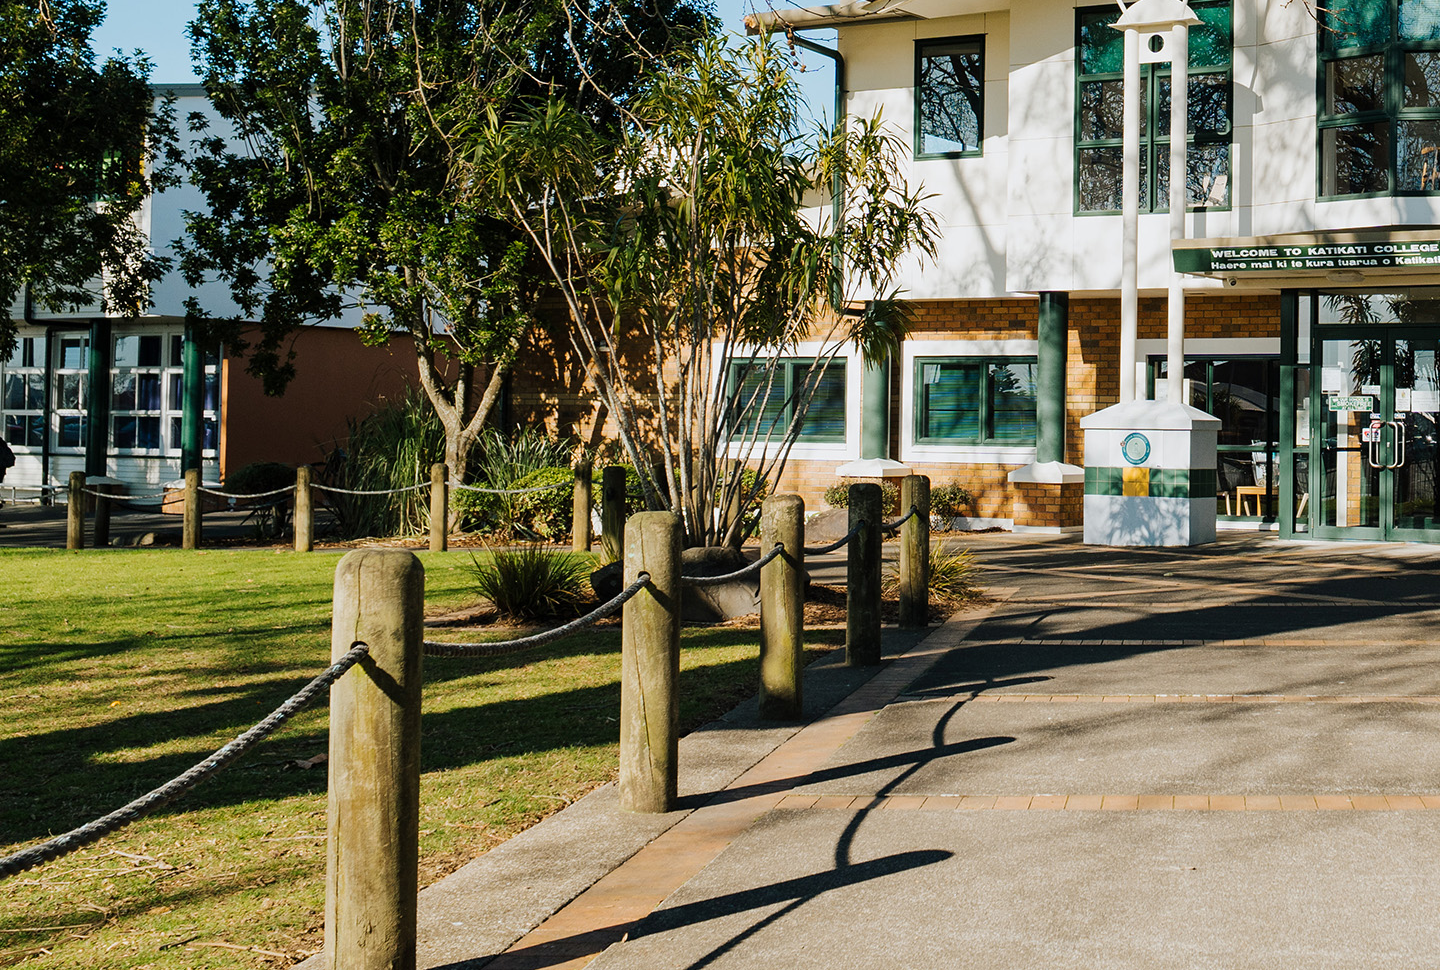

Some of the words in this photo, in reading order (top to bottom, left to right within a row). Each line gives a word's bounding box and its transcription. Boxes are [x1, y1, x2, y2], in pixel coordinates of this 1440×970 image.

[1211, 249, 1278, 258] WELCOME
[1284, 248, 1302, 256] TO
[1307, 246, 1367, 256] KATIKATI
[1373, 243, 1440, 253] COLLEGE
[1251, 260, 1272, 269] mai
[1276, 260, 1287, 268] ki
[1291, 260, 1303, 268] te
[1306, 259, 1334, 267] kura
